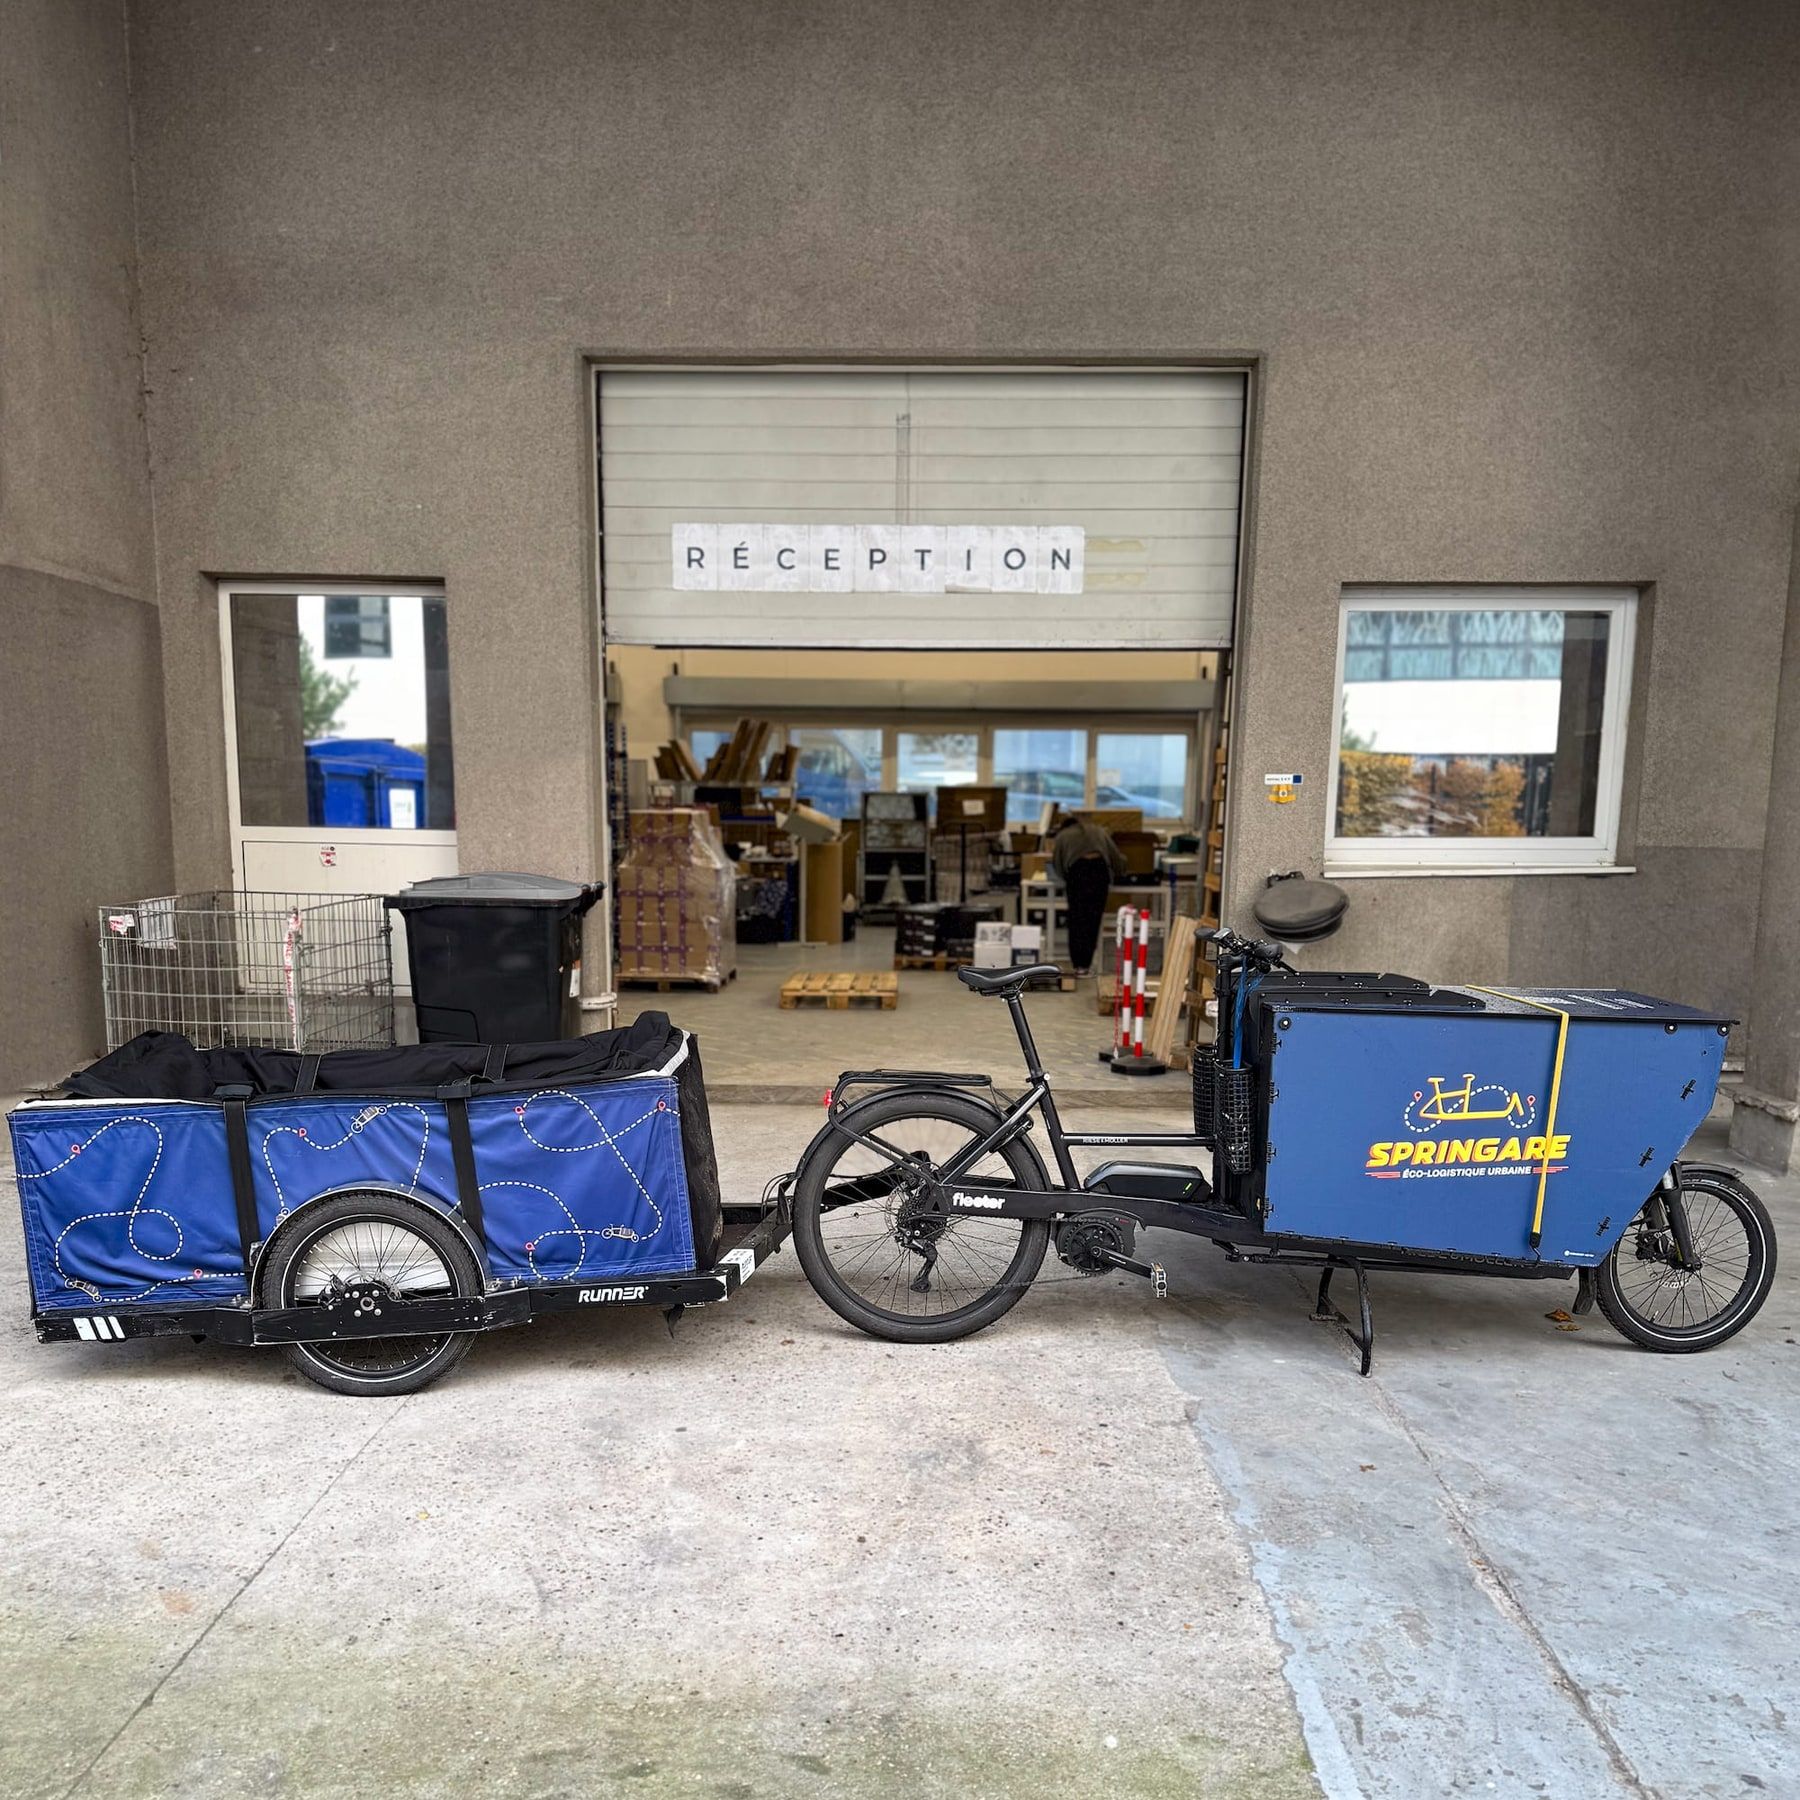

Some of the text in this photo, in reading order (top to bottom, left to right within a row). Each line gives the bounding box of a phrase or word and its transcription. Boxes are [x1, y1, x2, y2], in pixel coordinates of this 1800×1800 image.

[687, 541, 1071, 571] RÉCEPTION
[1365, 1134, 1571, 1168] SPRINGARE
[1402, 1166, 1532, 1179] ÉCO-LOGISTIQUE URBAINE
